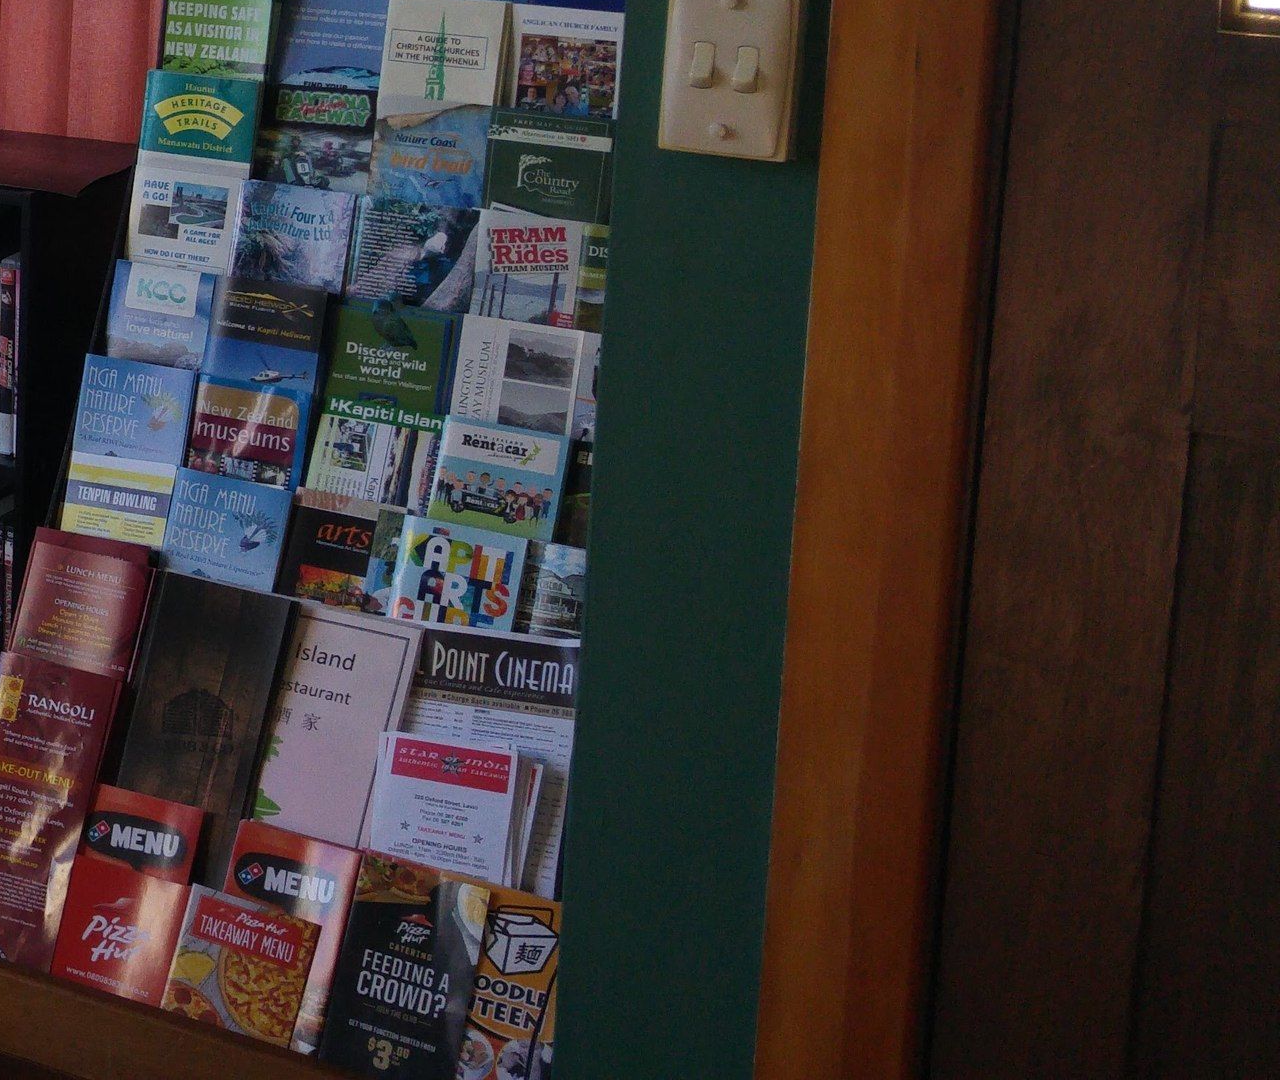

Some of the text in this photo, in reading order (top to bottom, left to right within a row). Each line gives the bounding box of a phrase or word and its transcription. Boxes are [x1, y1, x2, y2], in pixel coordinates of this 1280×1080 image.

[168, 1, 263, 22] KEEPING SAFE
[166, 21, 183, 36] AS
[183, 22, 193, 37] A
[194, 23, 243, 41] VISITOR
[424, 36, 448, 44] GUIDE
[451, 38, 461, 46] TO
[166, 41, 197, 58] NEW
[396, 42, 480, 58] CHRISTIAN CHURCHES
[405, 53, 421, 61] THE
[171, 98, 228, 115] HERITAGE
[176, 117, 219, 132] TRAILS
[144, 180, 171, 191] HAVE
[524, 171, 580, 191] Country
[143, 191, 170, 202] A GO!
[490, 226, 566, 245] TRAM
[492, 244, 569, 265] Rides
[501, 265, 528, 274] TRAM
[530, 266, 569, 275] MUSEUM
[136, 276, 187, 304] KCC
[127, 322, 150, 336] love
[153, 328, 194, 344] nature!
[346, 340, 411, 362] Discover
[359, 364, 402, 380] world
[362, 355, 390, 367] rare
[402, 359, 427, 373] wild
[84, 389, 136, 416] NATURE
[80, 411, 140, 440] RESERVE
[196, 420, 291, 453] museums
[461, 434, 497, 452] Rent
[505, 443, 529, 457] car
[77, 486, 158, 512] TENPIN BOWLING
[174, 502, 228, 534] NATURE
[317, 522, 375, 549] arts
[65, 565, 123, 584] LUNCH MENU
[295, 641, 357, 672] Island
[431, 640, 575, 696] POINT CINEMA
[27, 693, 96, 721] RANGOLI
[42, 770, 75, 790] MENU
[109, 823, 180, 858] MENU
[411, 837, 468, 854] OPENING HOURS
[263, 866, 335, 904] MENU
[234, 911, 288, 936] Pizza Hut
[396, 920, 431, 936] Pizza
[200, 913, 296, 964] TAKEAWAY MENU
[399, 932, 429, 946] Hut
[388, 942, 434, 962] CATERING
[361, 948, 449, 994] FEEDING A
[356, 970, 447, 1019] CROWD?
